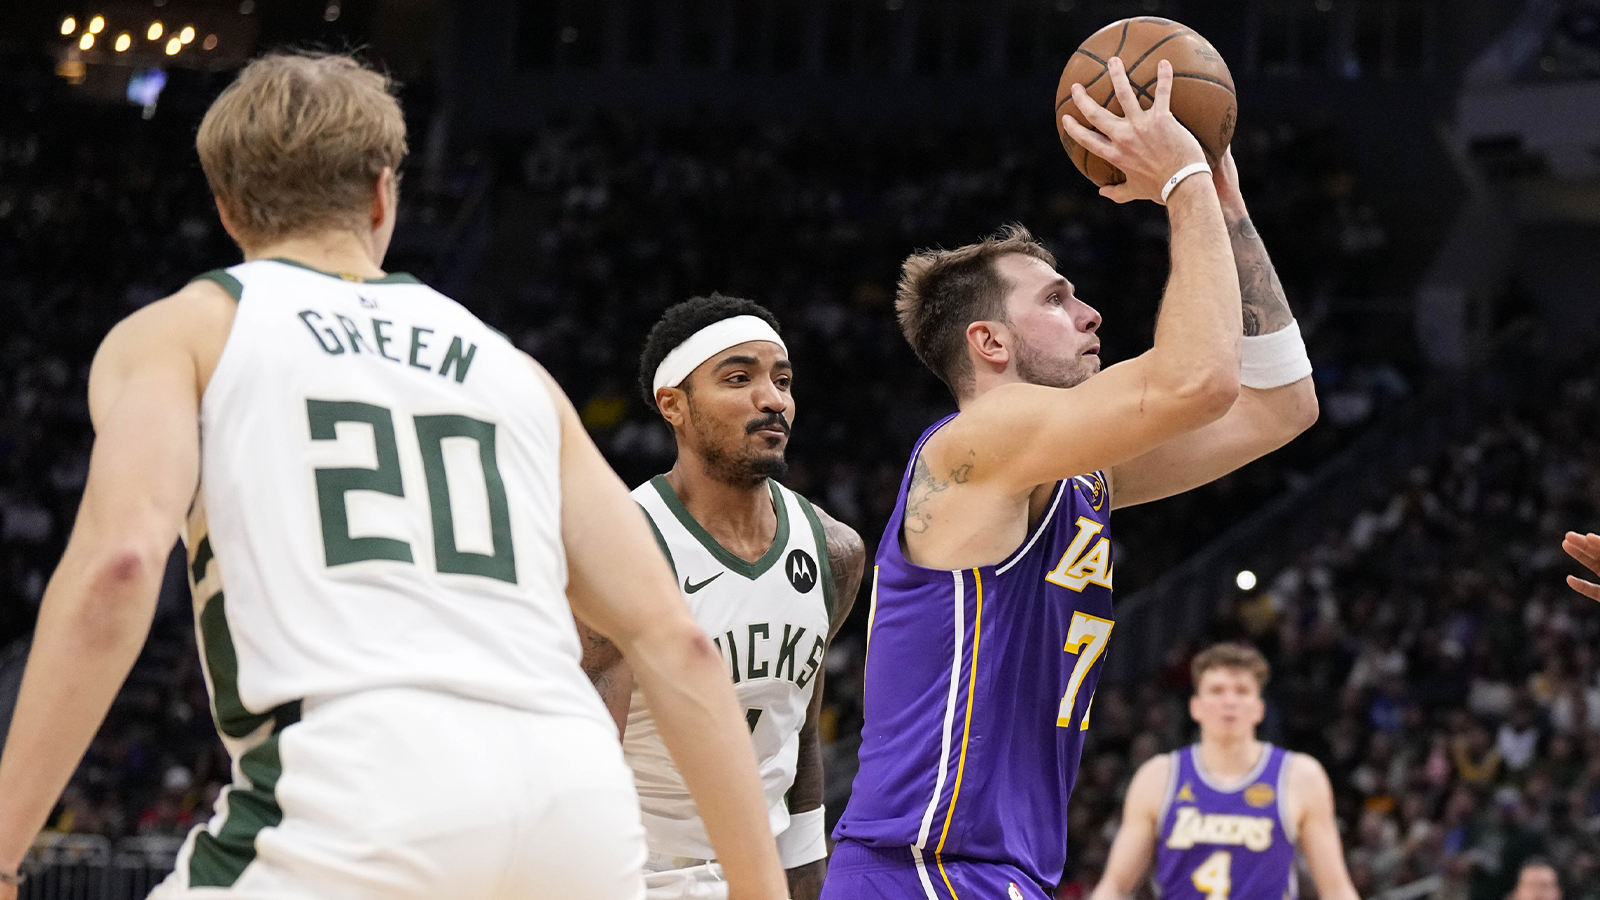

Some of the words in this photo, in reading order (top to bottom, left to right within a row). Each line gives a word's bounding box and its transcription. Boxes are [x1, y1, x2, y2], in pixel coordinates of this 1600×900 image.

[298, 310, 478, 384] GREEN
[305, 398, 518, 585] 20
[1045, 516, 1114, 593] LA
[712, 622, 825, 690] UCKS
[1056, 610, 1116, 731] 7
[1165, 806, 1275, 853] LAKERS
[1191, 850, 1232, 900] 4
